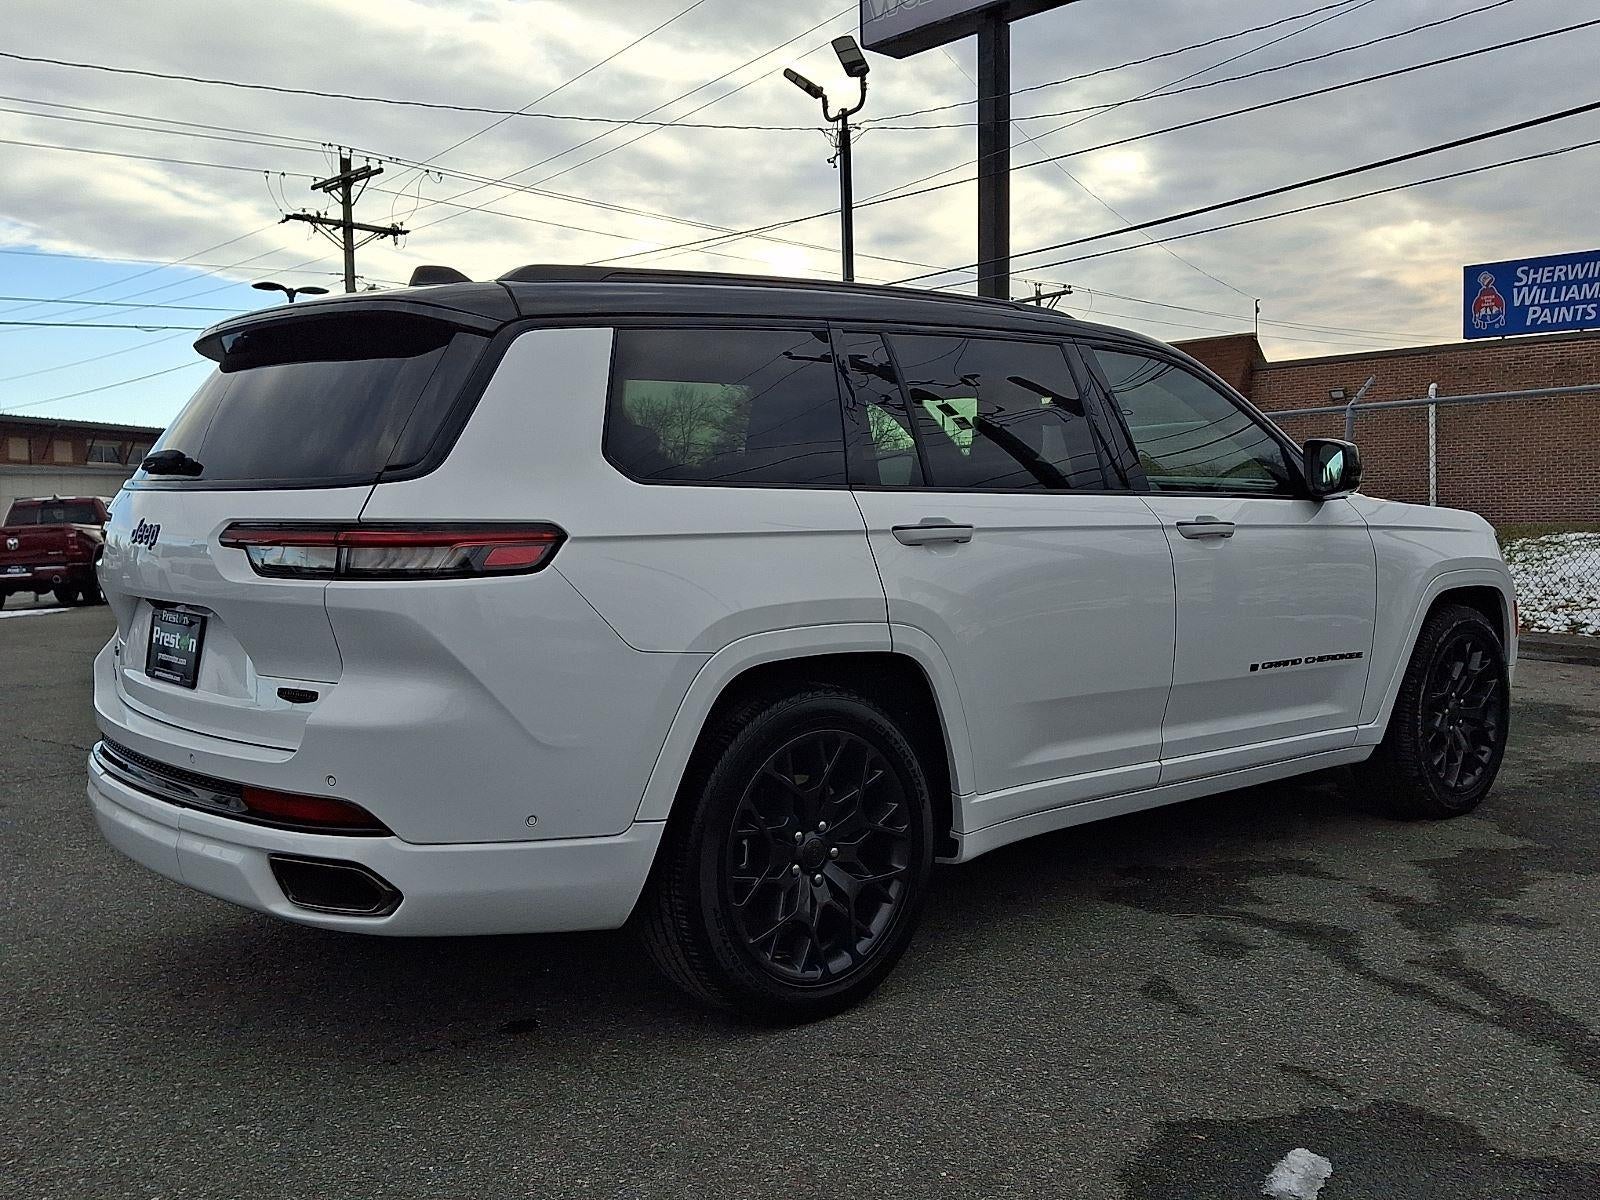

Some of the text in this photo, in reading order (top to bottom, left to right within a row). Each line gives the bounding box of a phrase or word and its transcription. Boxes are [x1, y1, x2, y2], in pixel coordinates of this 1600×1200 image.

[1512, 282, 1600, 307] WILLIAM
[1525, 303, 1598, 326] PAINTS
[131, 517, 161, 551] Jeep
[1261, 651, 1364, 670] GRAND CHEROKEE
